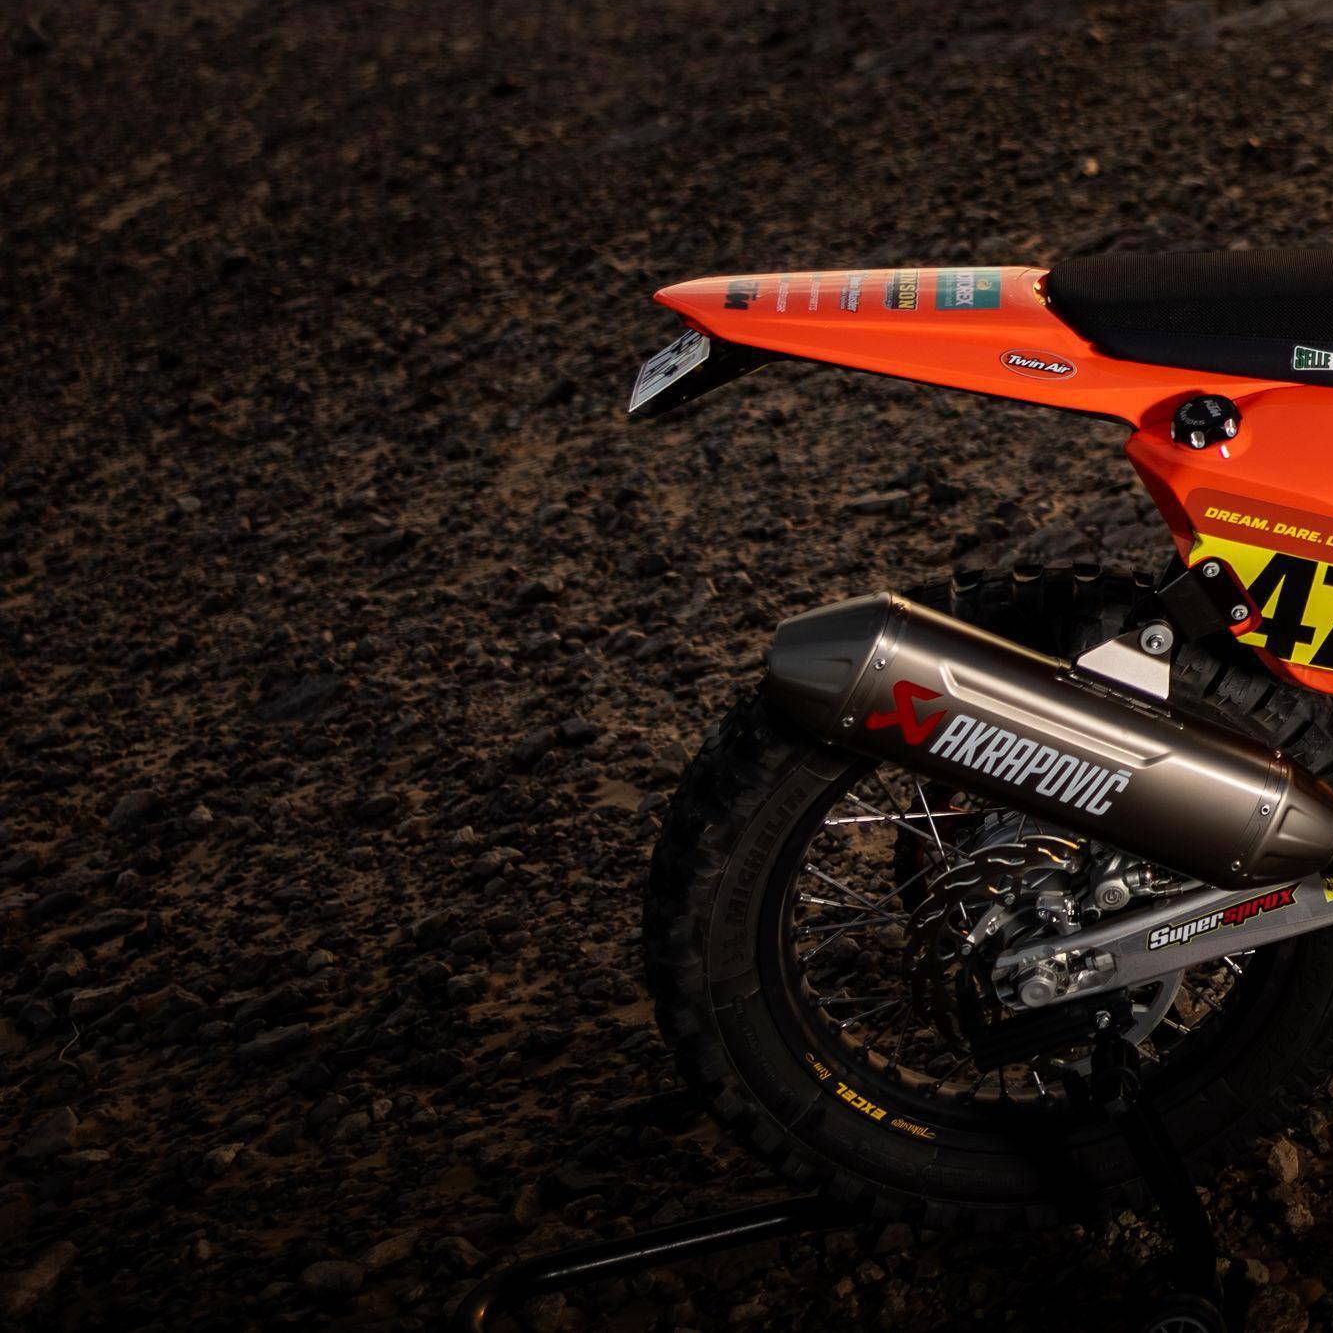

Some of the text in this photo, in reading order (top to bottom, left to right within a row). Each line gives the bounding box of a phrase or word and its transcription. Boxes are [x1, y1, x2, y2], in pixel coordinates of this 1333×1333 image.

[898, 269, 917, 309] INSON
[955, 271, 974, 307] OTOREX
[1008, 354, 1071, 374] Twin Air
[1295, 347, 1331, 369] SELLE
[1205, 507, 1271, 532] DREAM.
[1273, 523, 1323, 544] DARE.
[1150, 887, 1294, 950] Supersprox
[835, 1082, 887, 1120] EXCEL
